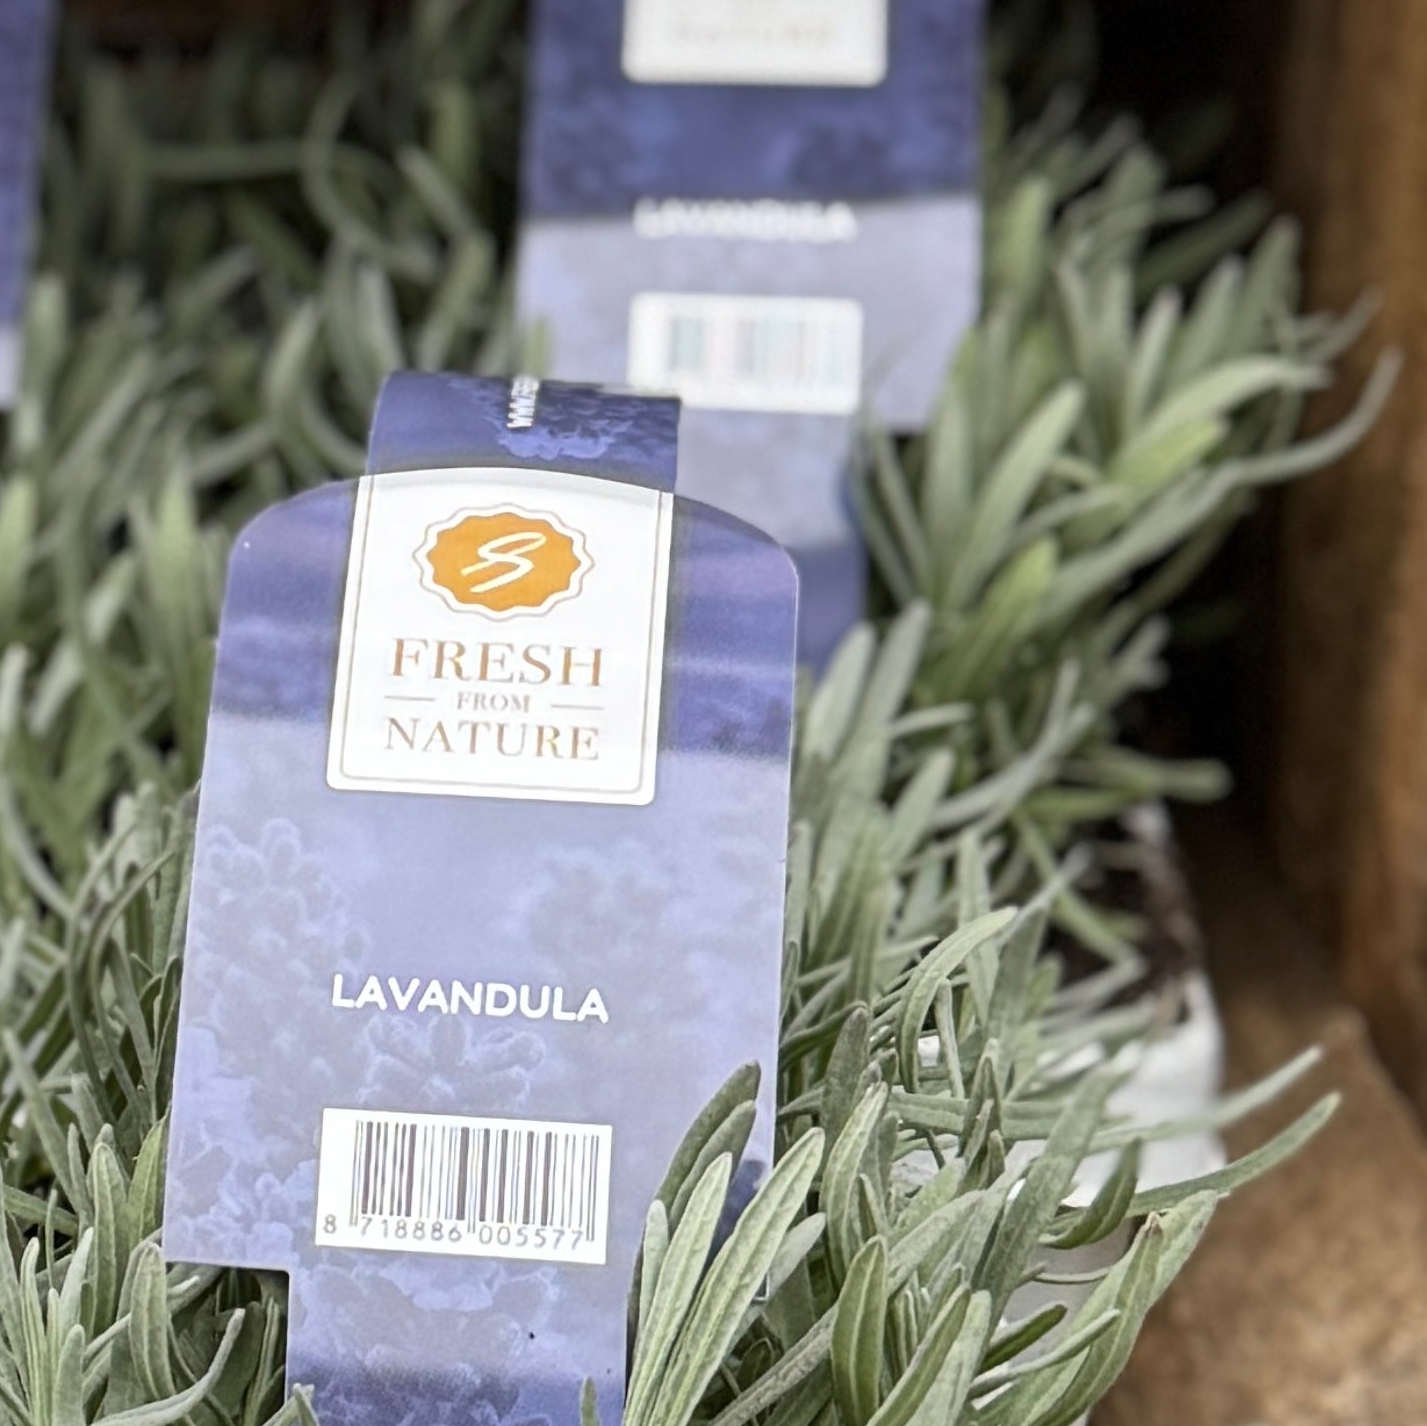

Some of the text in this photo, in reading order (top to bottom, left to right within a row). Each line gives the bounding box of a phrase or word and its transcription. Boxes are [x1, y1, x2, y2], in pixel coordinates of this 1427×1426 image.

[390, 636, 604, 689] FRESH
[455, 690, 532, 714] FROM
[382, 717, 601, 761] NATURE
[331, 974, 609, 1023] LAVANDULA
